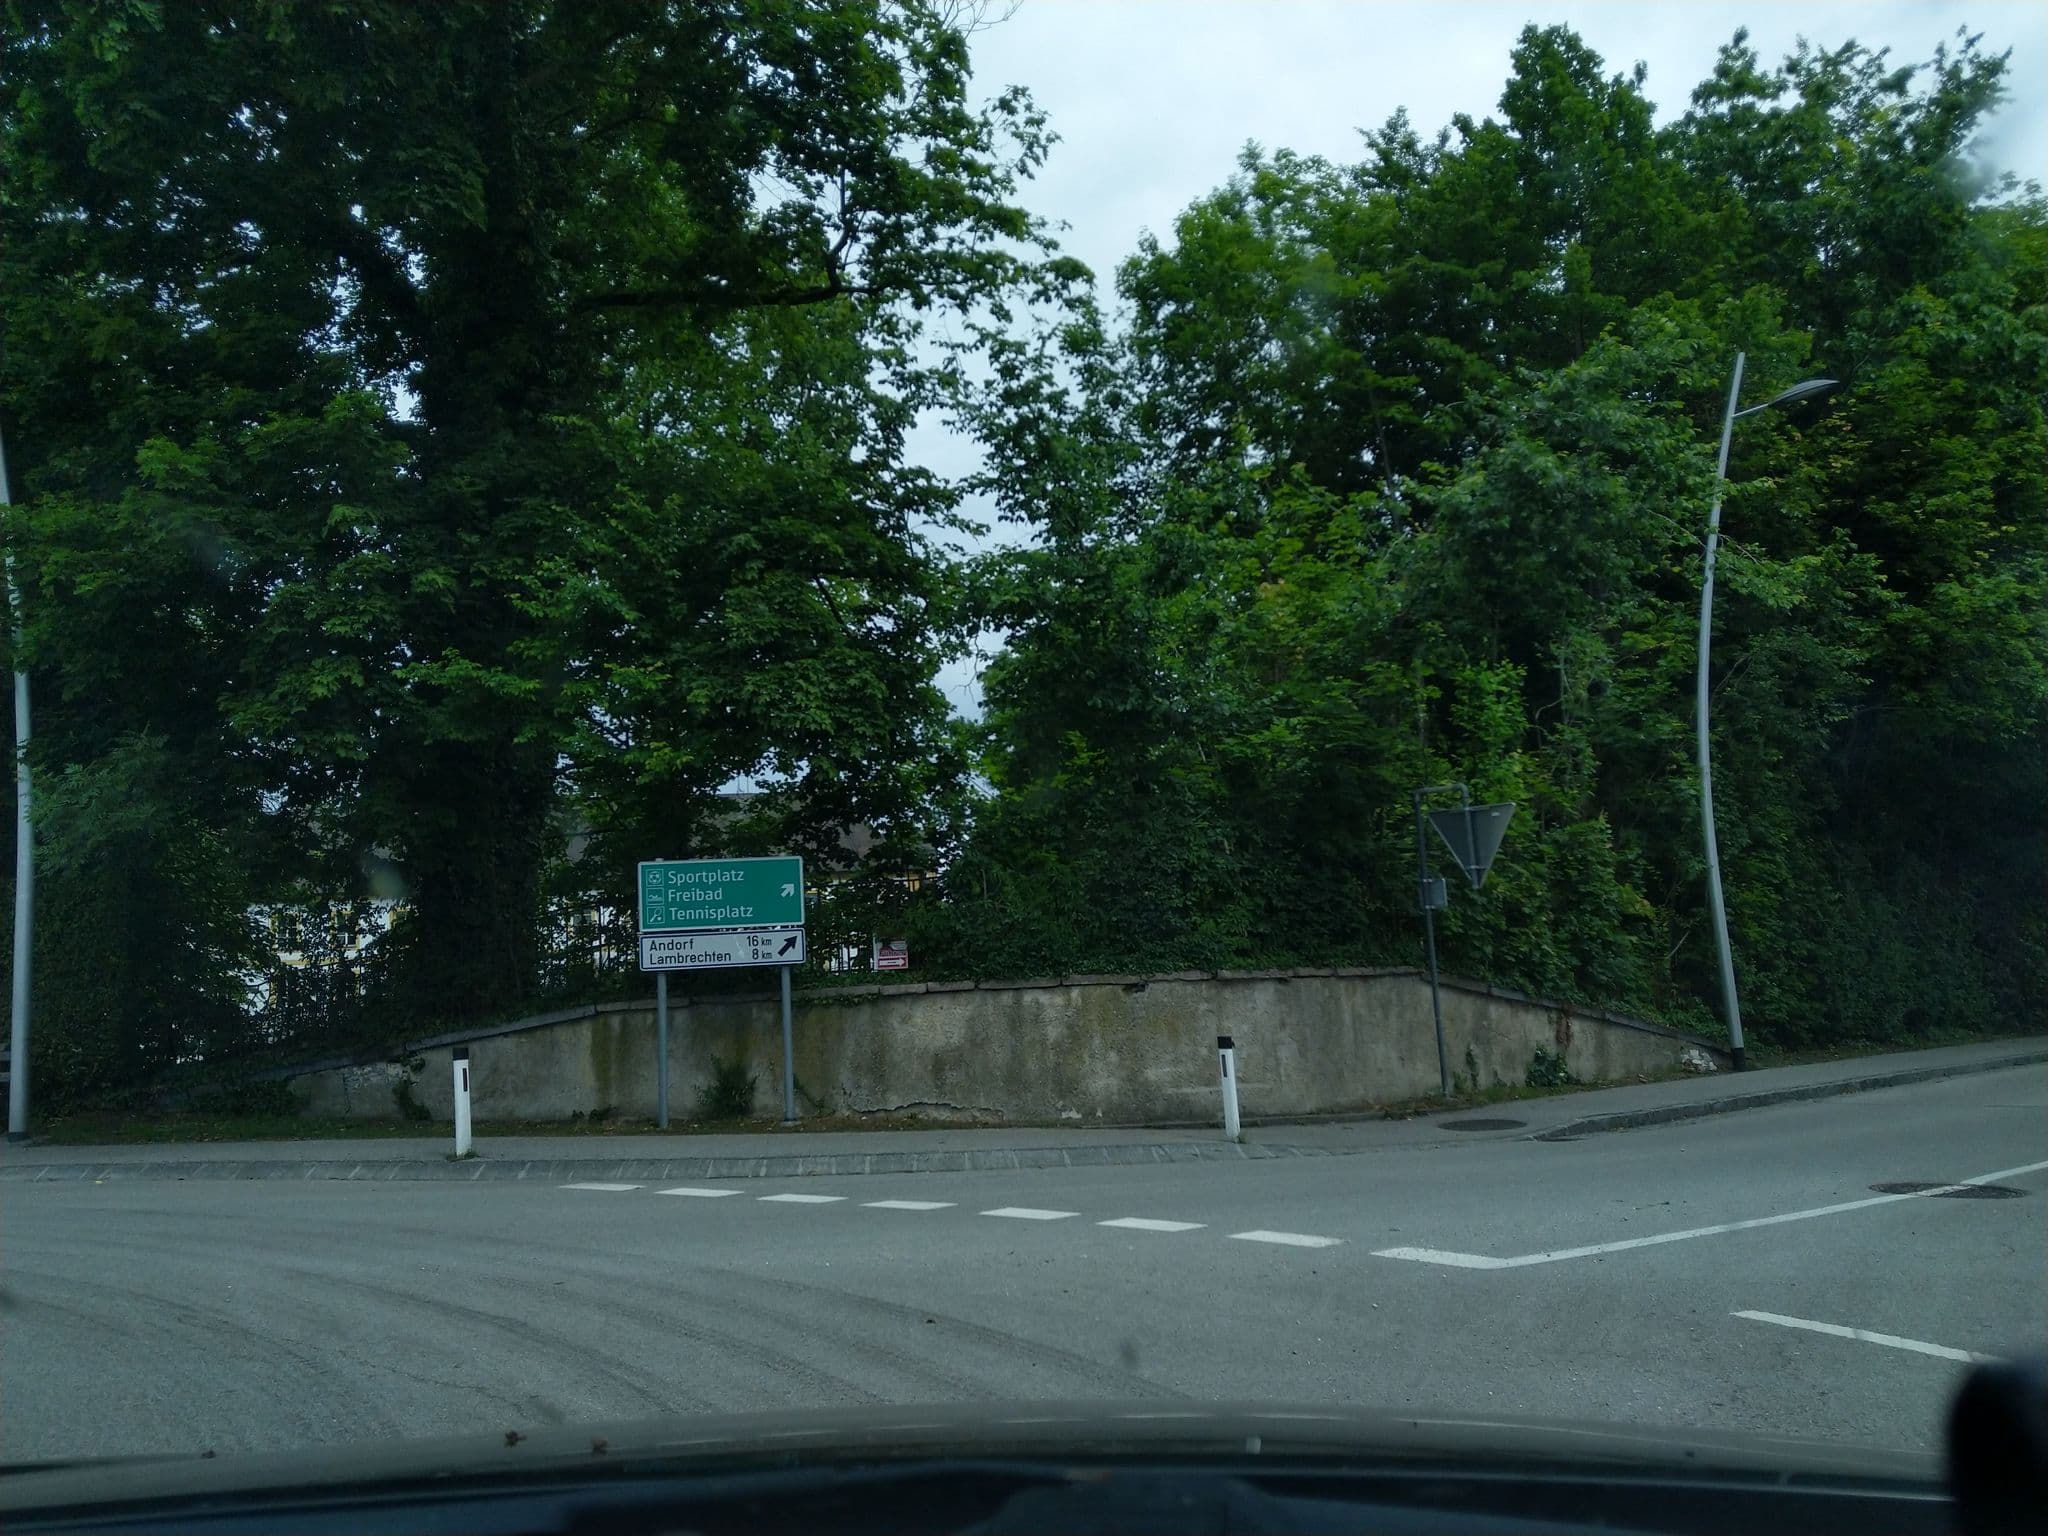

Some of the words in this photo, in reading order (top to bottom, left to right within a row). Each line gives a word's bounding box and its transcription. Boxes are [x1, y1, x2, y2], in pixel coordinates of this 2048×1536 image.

[668, 869, 744, 886] Sportplatz
[668, 888, 723, 902] Freibad
[669, 906, 753, 921] Tennisplatz
[650, 938, 694, 951] Andorf
[747, 935, 759, 947] 16
[761, 937, 773, 946] km
[650, 951, 731, 965] Lambrechten
[752, 949, 759, 960] 8
[761, 951, 773, 960] km
